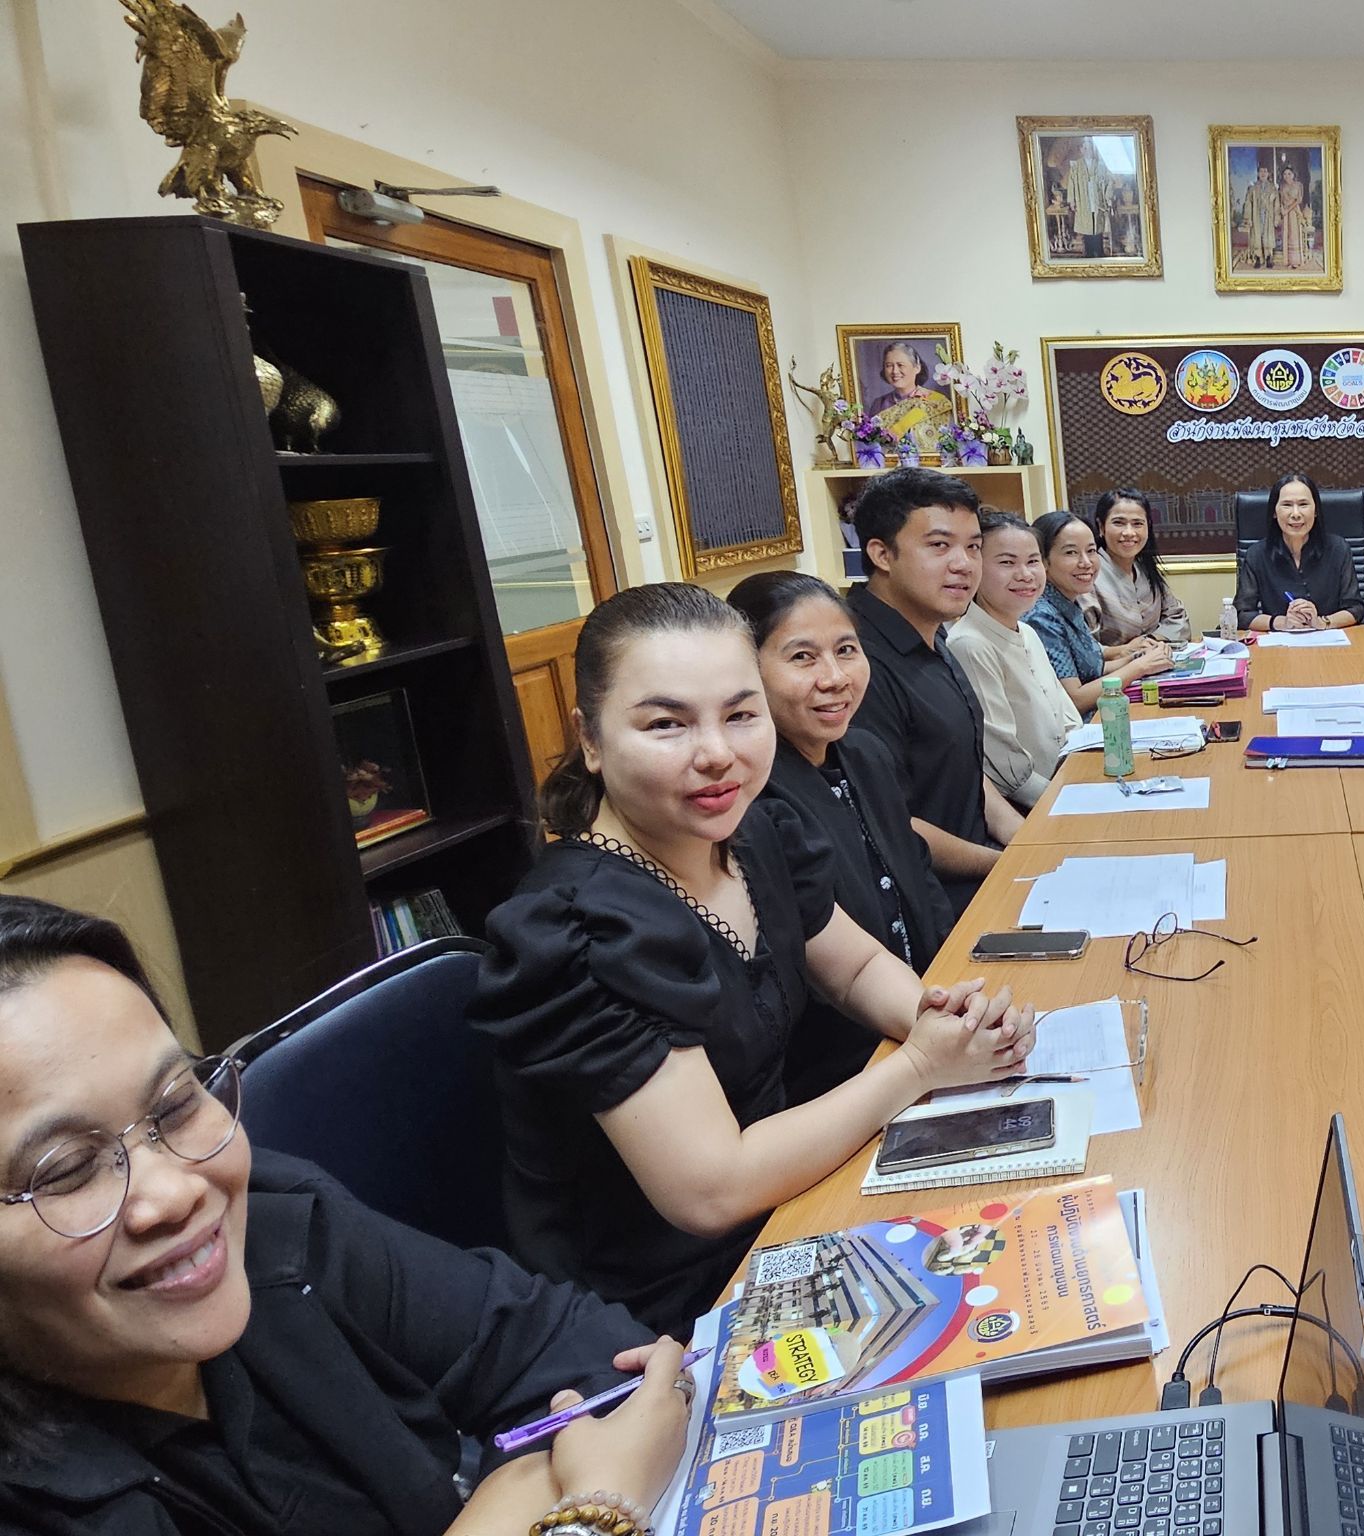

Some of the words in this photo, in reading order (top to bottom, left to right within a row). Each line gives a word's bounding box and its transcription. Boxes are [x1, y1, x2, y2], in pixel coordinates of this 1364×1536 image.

[1003, 1119, 1017, 1129] 44
[1018, 1116, 1031, 1126] 09
[1046, 1225, 1069, 1298] การพัฒนาชุมชน
[786, 1334, 819, 1383] STRATEGY
[788, 1424, 798, 1438] Q&A
[920, 1455, 931, 1474] ส.ค.
[921, 1488, 932, 1508] ก.ย.
